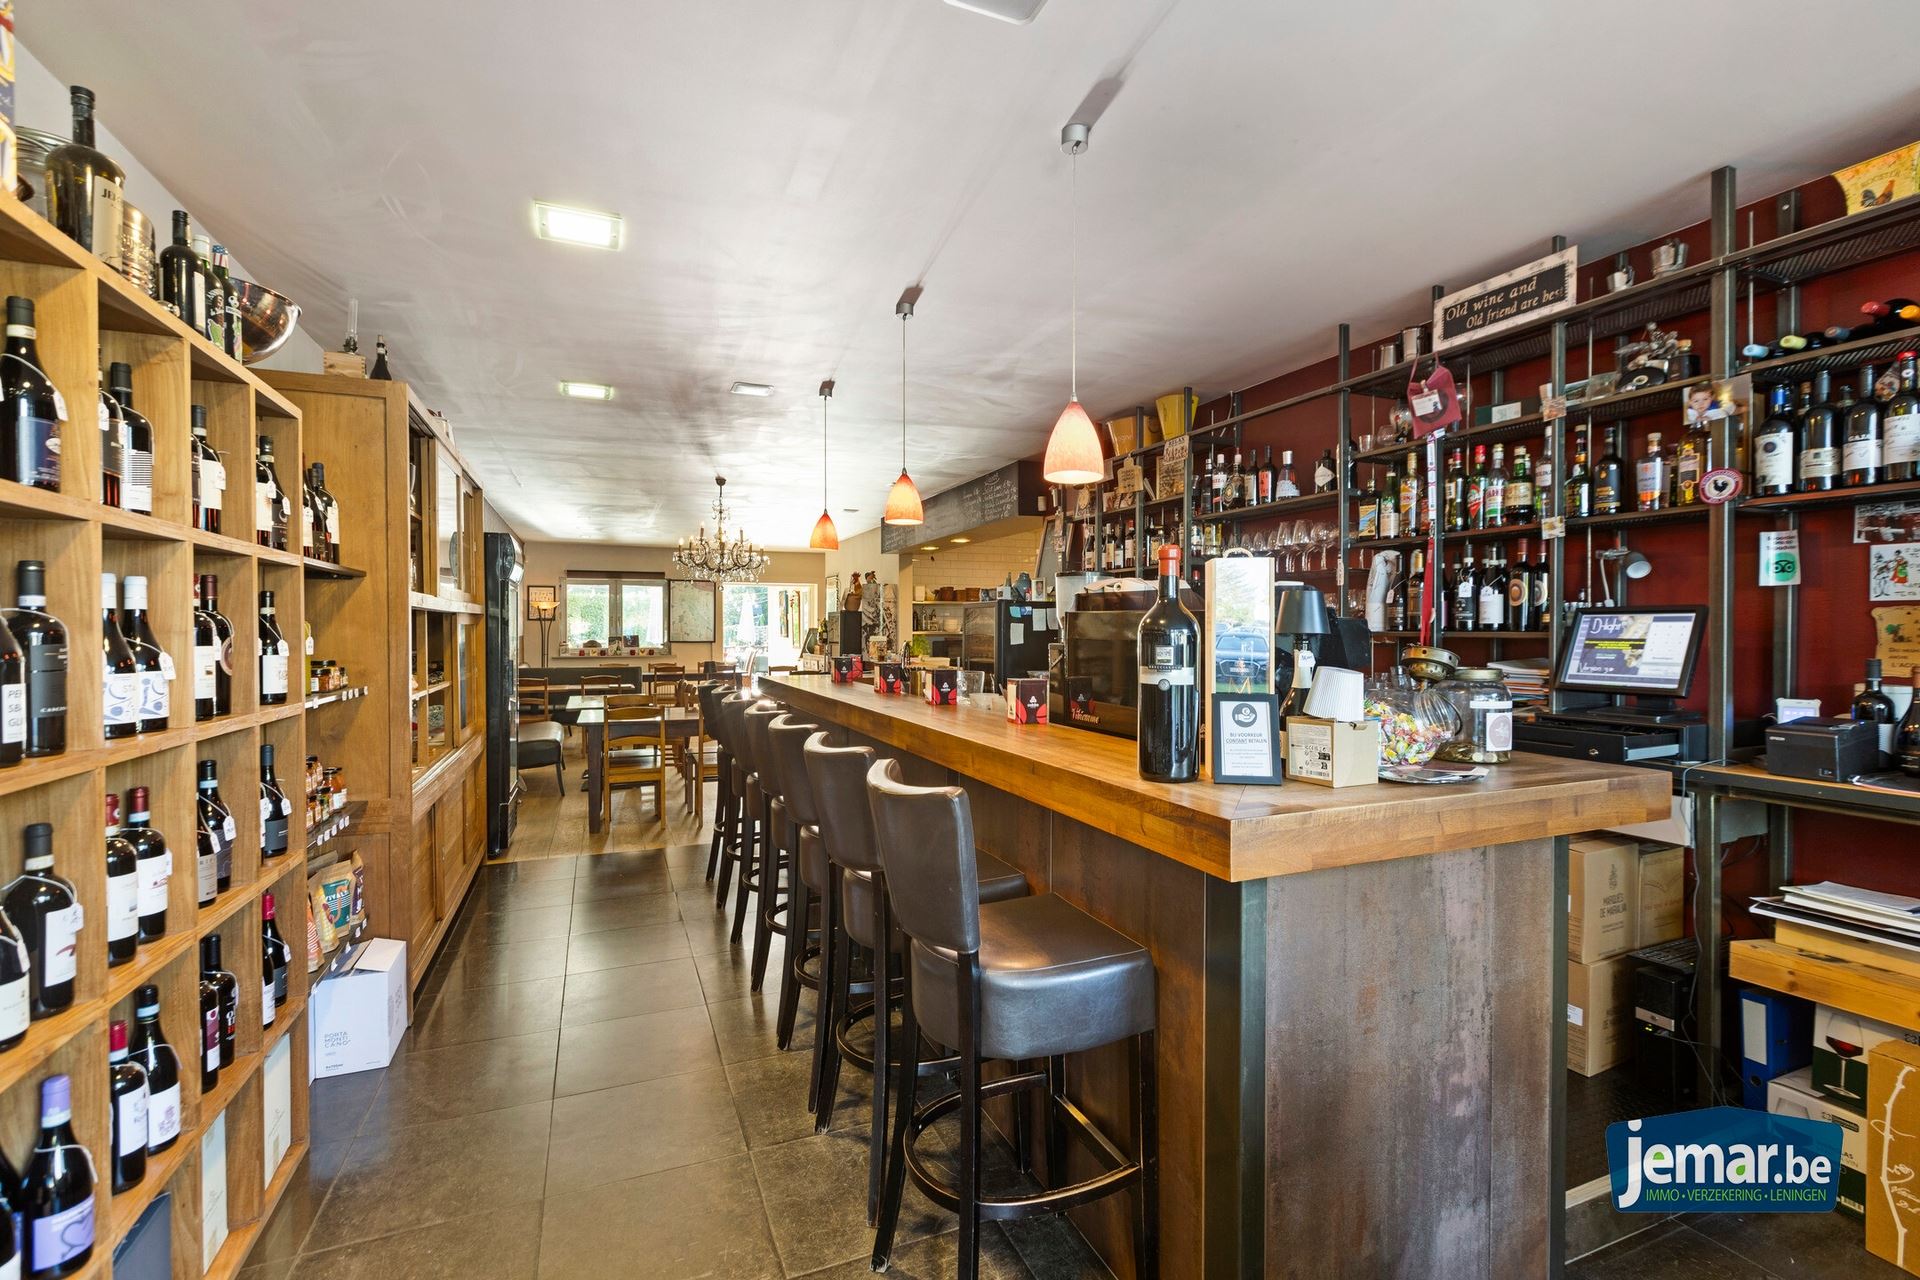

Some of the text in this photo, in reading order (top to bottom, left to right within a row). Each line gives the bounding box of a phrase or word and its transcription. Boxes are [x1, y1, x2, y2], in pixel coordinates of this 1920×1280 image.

[1446, 276, 1537, 321] Old wine and
[1466, 313, 1484, 329] Old
[1485, 302, 1518, 325] friend
[1520, 297, 1539, 311] are
